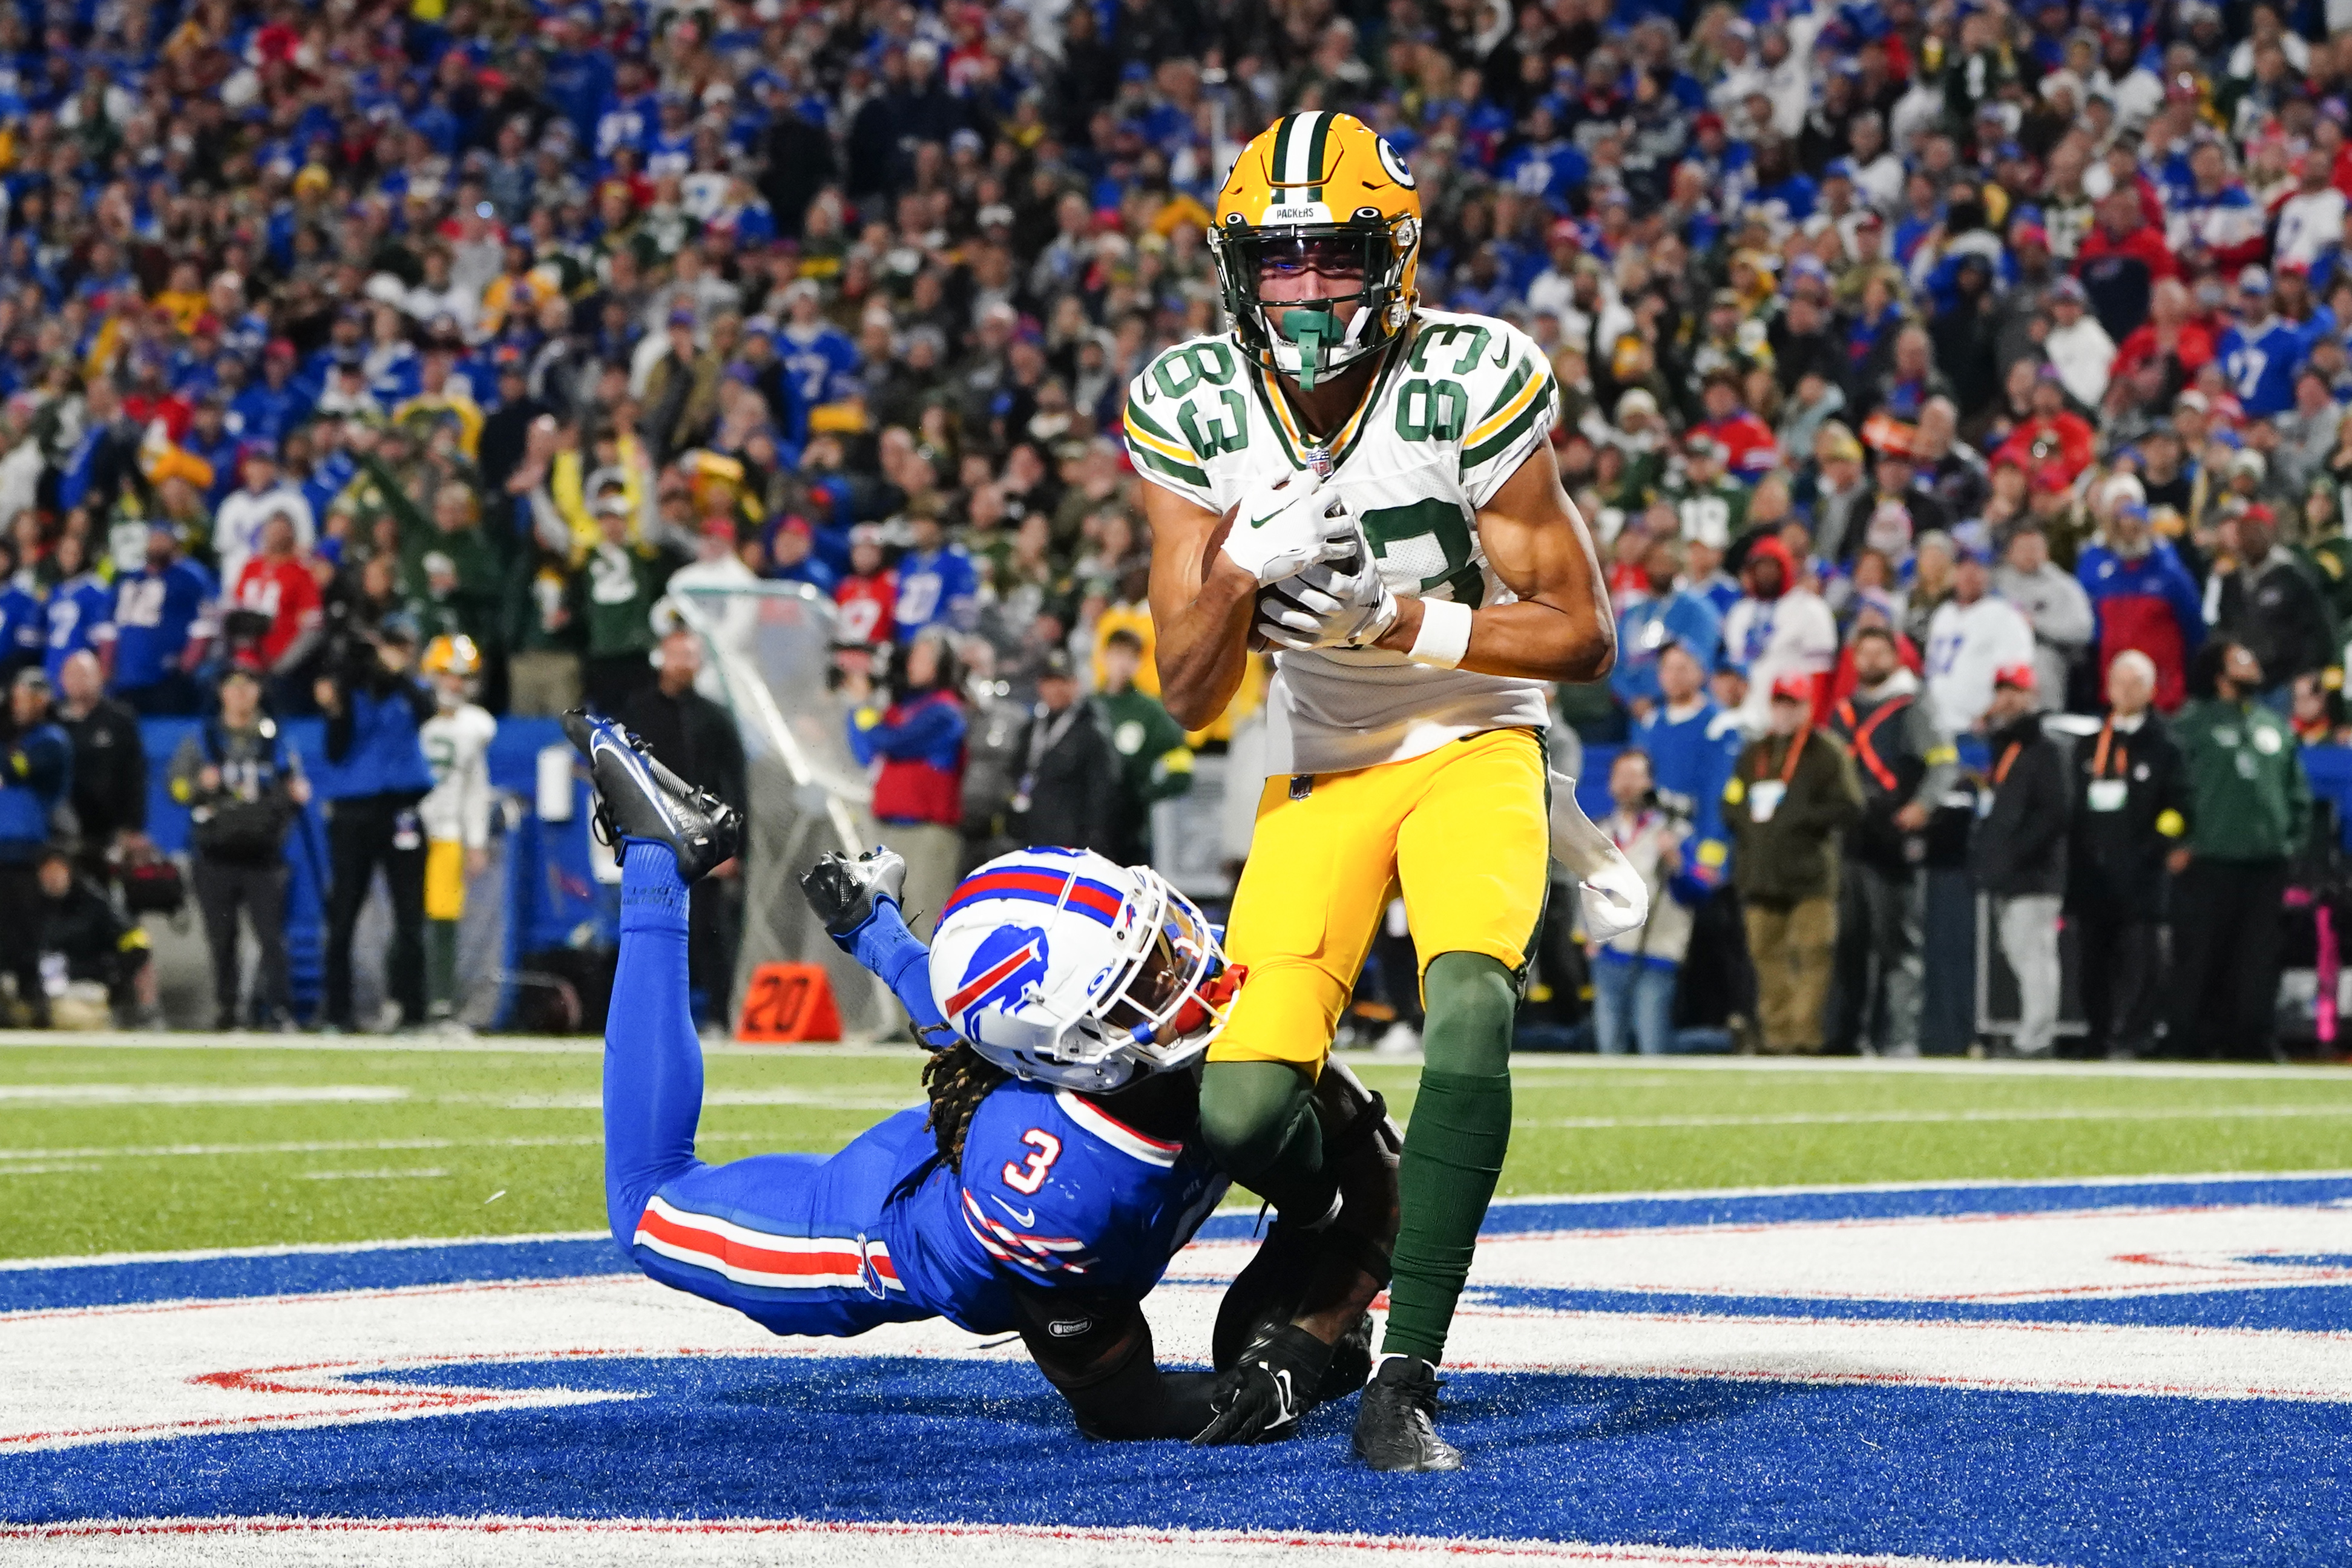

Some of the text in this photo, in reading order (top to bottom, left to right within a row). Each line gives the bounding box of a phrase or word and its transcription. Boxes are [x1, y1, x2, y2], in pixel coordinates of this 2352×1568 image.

[1276, 208, 1313, 219] PACKERS
[1152, 342, 1248, 461] 83
[1395, 323, 1492, 443] 83
[745, 976, 809, 1032] 20
[1002, 1127, 1062, 1195] 3
